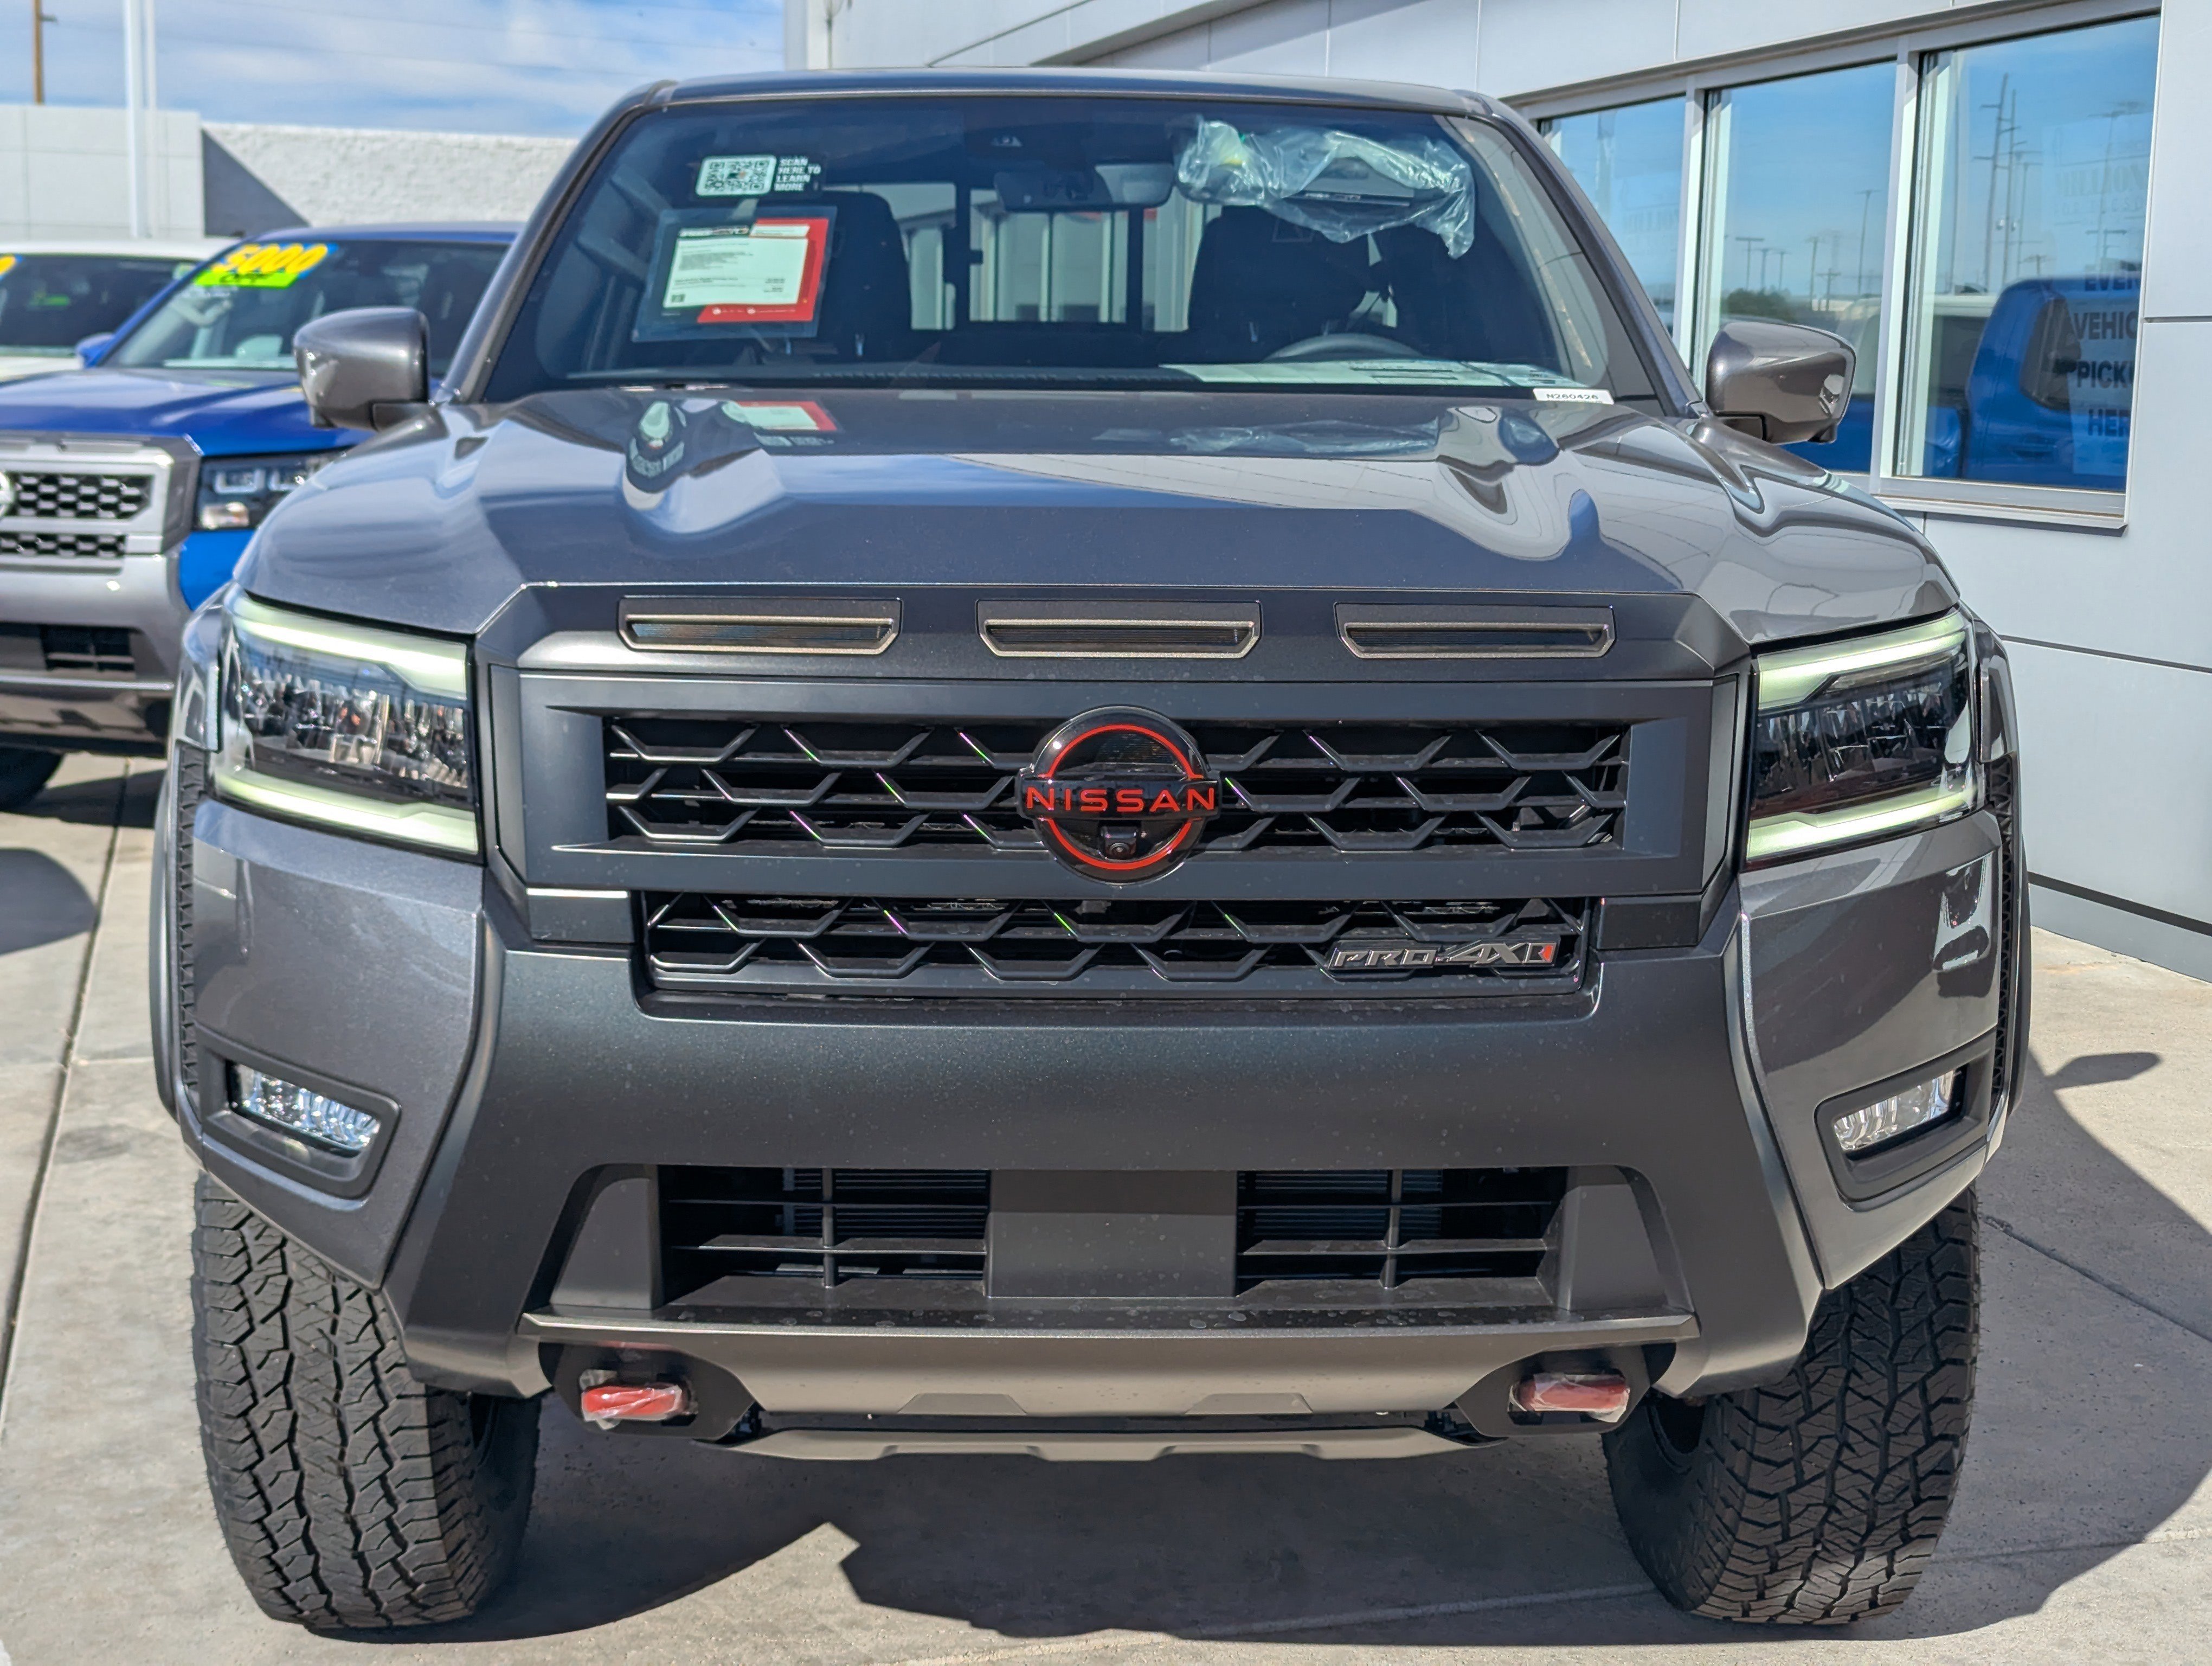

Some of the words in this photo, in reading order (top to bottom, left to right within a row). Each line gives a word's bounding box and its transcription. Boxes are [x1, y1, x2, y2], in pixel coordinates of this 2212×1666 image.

[780, 157, 808, 166] SCAN
[778, 166, 805, 175] HERE
[808, 164, 821, 174] TO
[776, 174, 811, 183] LEARN
[774, 183, 804, 191] MORE
[1025, 786, 1216, 812] NISSAN
